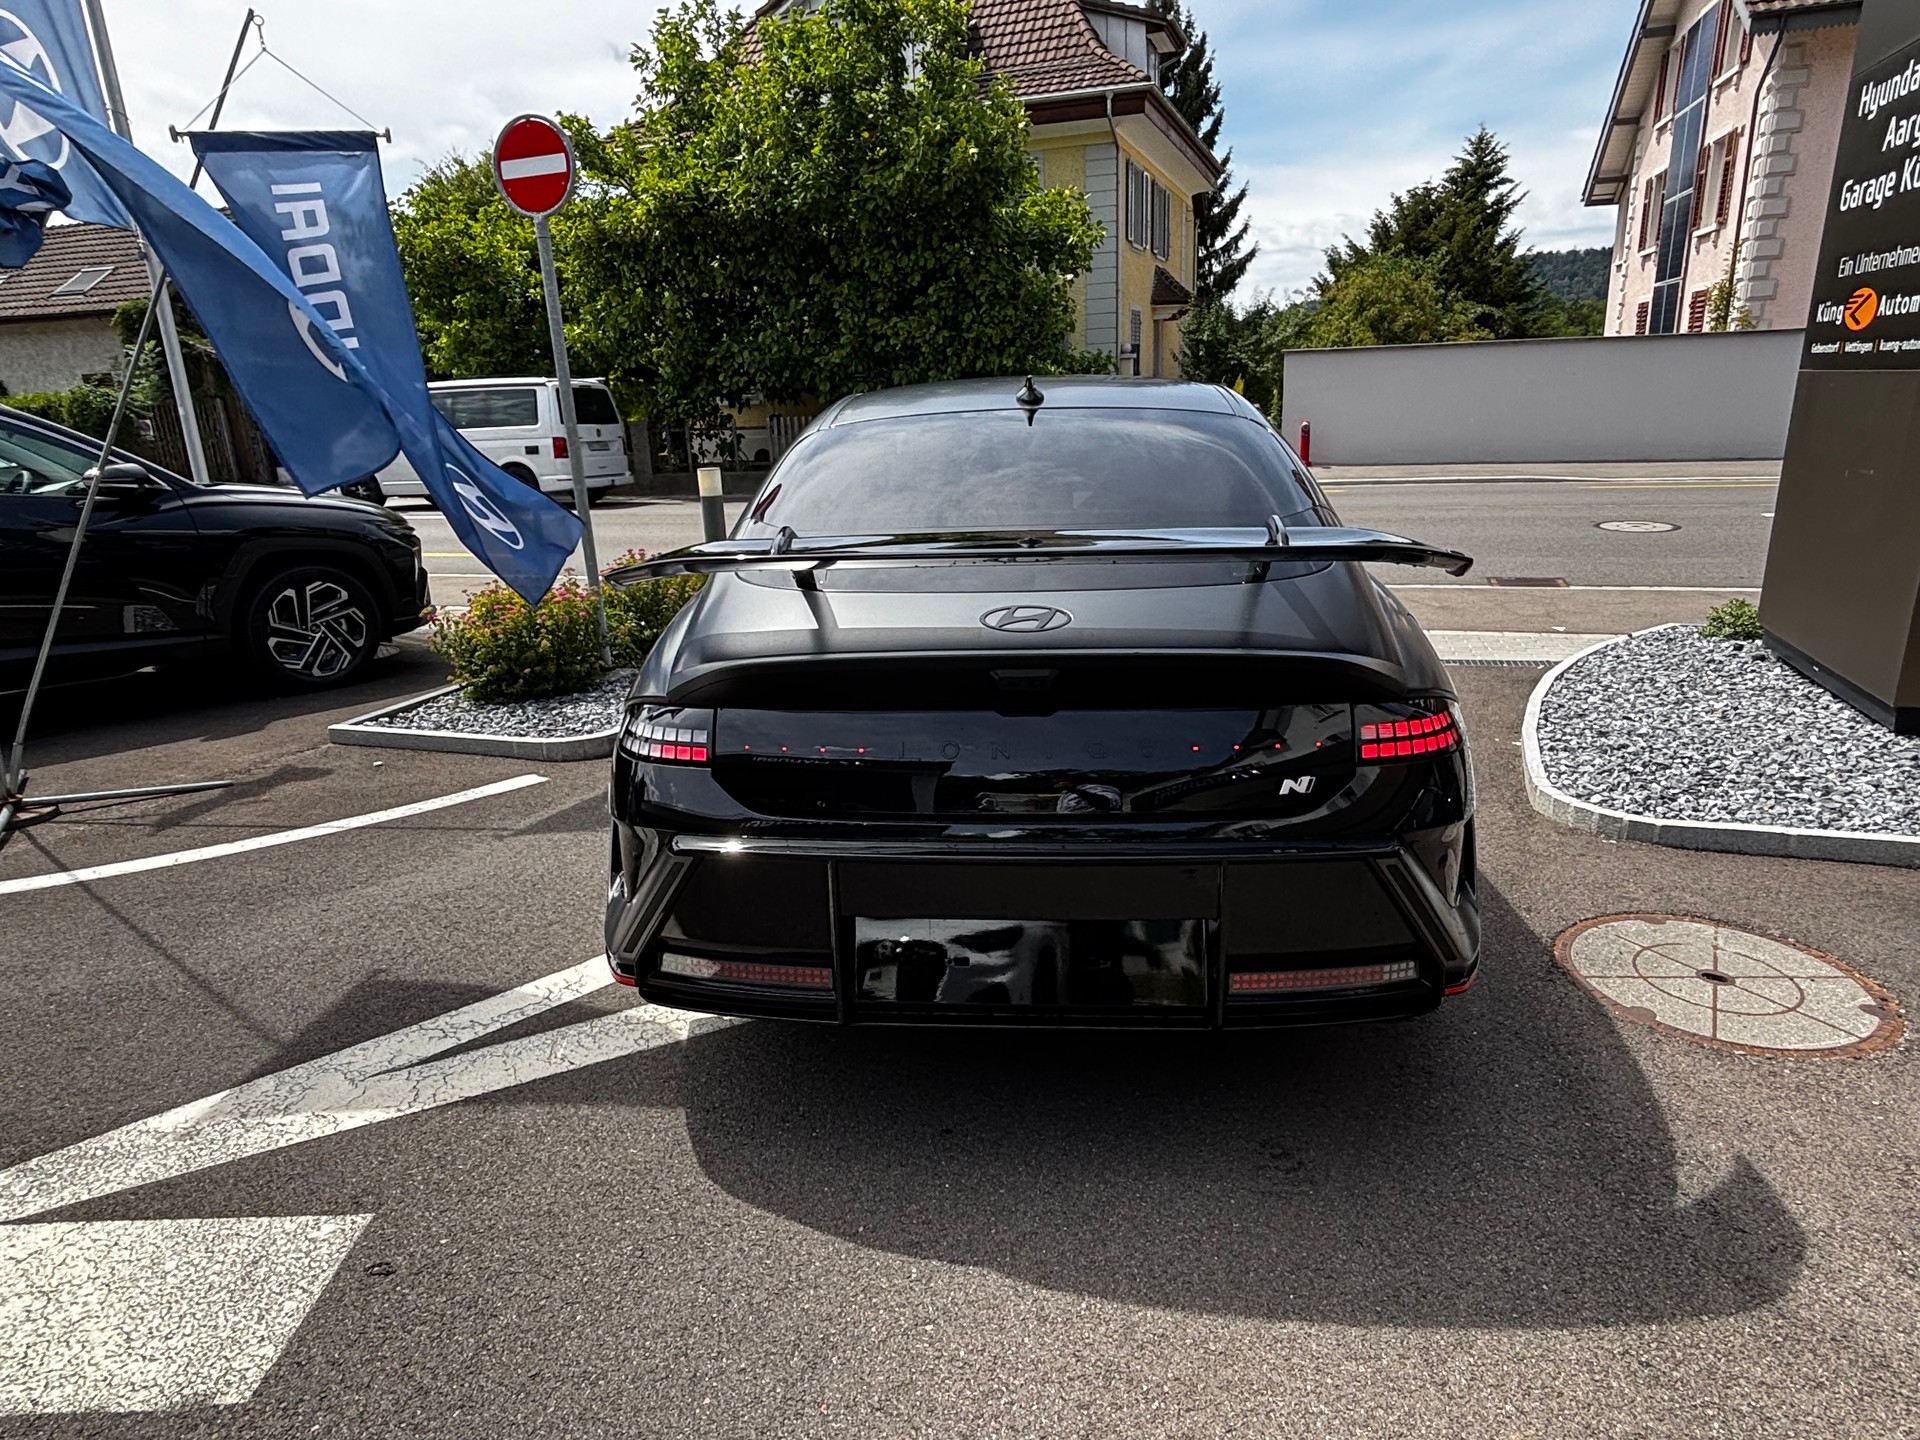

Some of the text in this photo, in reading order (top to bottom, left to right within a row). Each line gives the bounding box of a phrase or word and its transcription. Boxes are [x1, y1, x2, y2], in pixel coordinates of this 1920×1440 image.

[1839, 171, 1897, 212] Garage
[1838, 245, 1920, 278] Ein Unternehme
[1816, 301, 1845, 325] Küng
[1879, 338, 1920, 353] kueng-auto
